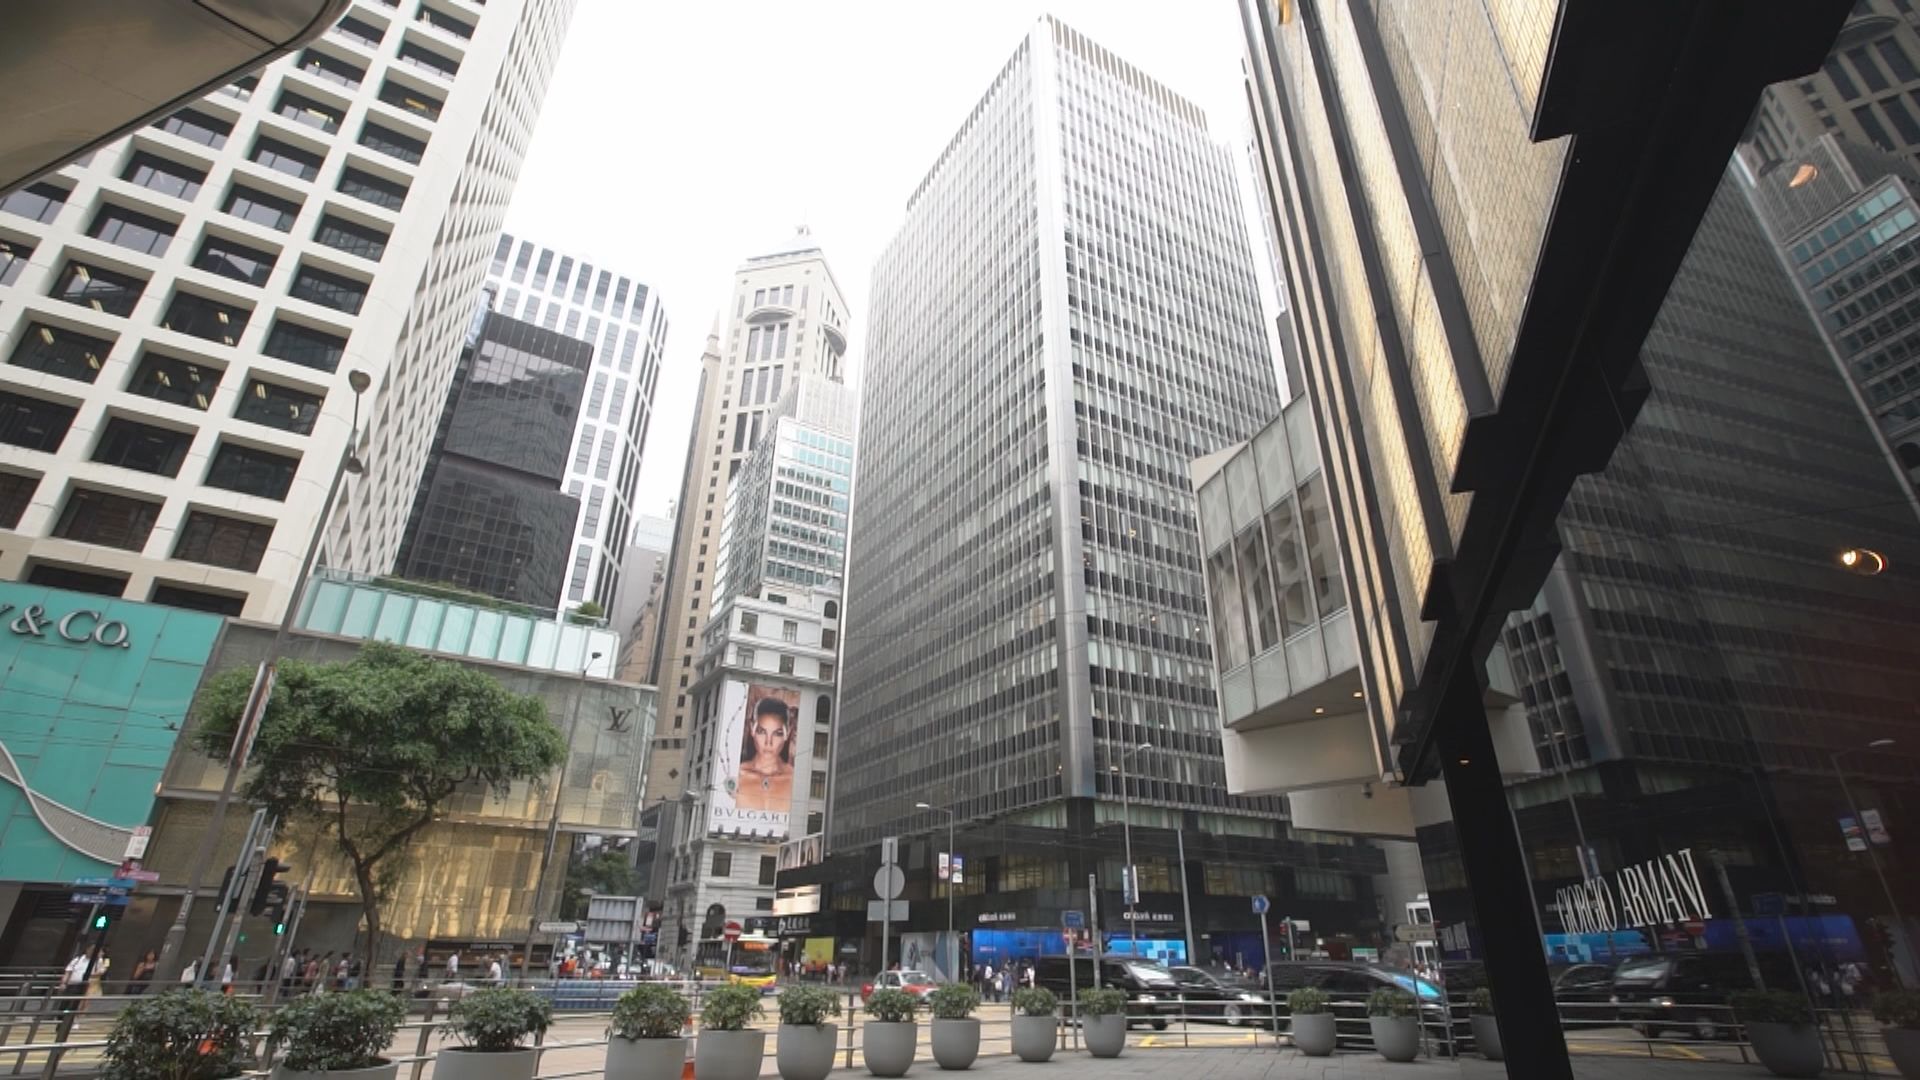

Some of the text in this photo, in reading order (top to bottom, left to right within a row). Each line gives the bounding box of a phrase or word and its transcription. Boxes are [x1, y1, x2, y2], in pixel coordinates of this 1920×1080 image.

[10, 605, 53, 636] &
[713, 806, 788, 823] BVLGARI
[1555, 847, 1712, 935] GIORGIO ARMANI
